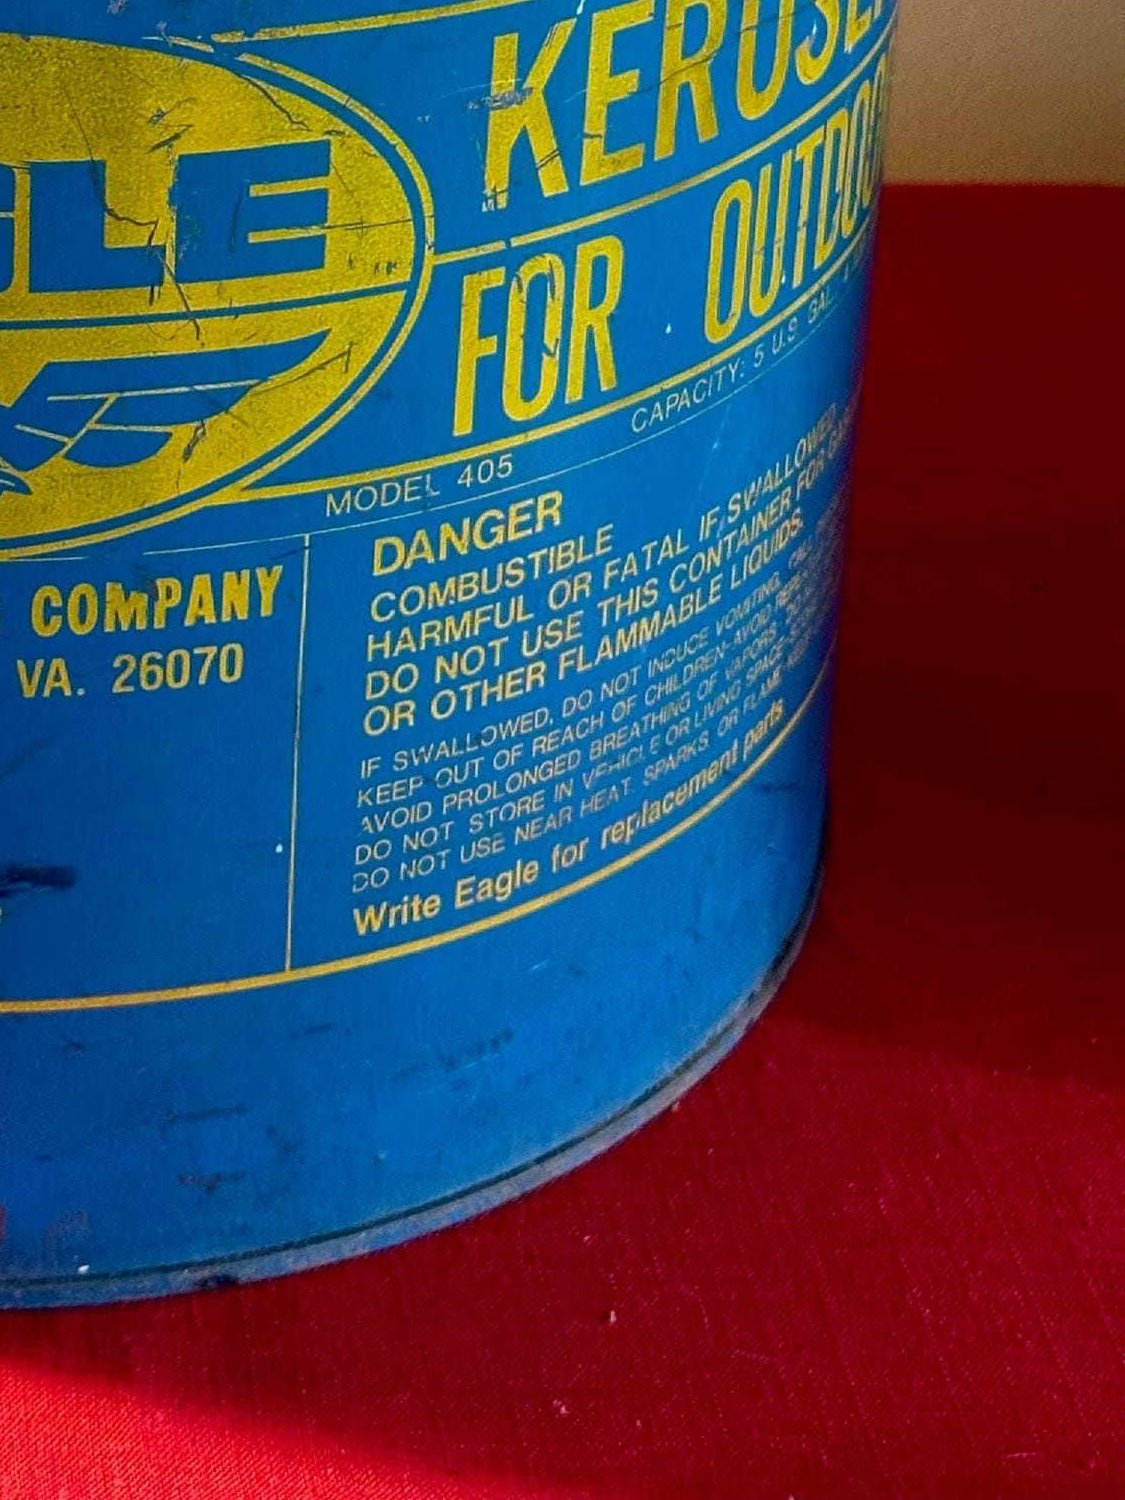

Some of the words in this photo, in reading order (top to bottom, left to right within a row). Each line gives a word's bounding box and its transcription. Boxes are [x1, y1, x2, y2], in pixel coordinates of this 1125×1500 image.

[453, 236, 624, 436] FOR
[703, 40, 891, 343] OUTDOO
[632, 357, 745, 433] CAPACITY:
[754, 344, 764, 368] 5
[326, 473, 440, 517] MODEL
[457, 453, 514, 489] 405
[372, 490, 563, 576] DANGER
[31, 565, 283, 638] COMPANY
[365, 663, 419, 701] DO
[435, 636, 509, 684] NOT
[522, 610, 584, 657] USE
[596, 577, 659, 627] THIS
[669, 485, 792, 594] CONTAINER
[367, 595, 534, 662] HARMFUL
[548, 571, 592, 611] OR
[602, 528, 689, 590] FATAL
[698, 506, 720, 543] IF
[370, 523, 614, 623] COMBUSTIBLE
[16, 657, 87, 698] VA.
[111, 642, 245, 694] 26070
[360, 756, 381, 779] IF
[562, 689, 593, 718] DO
[600, 665, 642, 702] NOT
[648, 626, 710, 679] INDUCE
[363, 699, 416, 736] OR
[430, 660, 547, 721] OTHER
[558, 572, 723, 681] FLAMMABLE
[353, 866, 390, 893] DO
[399, 849, 451, 881] NOT
[460, 832, 505, 864] USE
[514, 805, 572, 846] NEAR
[717, 706, 739, 737] OR
[353, 893, 442, 936] Write
[454, 859, 539, 910] Eagle
[551, 837, 590, 874] for
[600, 738, 740, 850] replacement
[743, 697, 784, 762] parts
[355, 839, 392, 865] DO
[403, 821, 454, 853] NOT
[469, 790, 545, 834] STORE
[554, 778, 574, 804] IN
[665, 717, 690, 747] OR
[695, 678, 741, 728] LIVING
[357, 775, 423, 808] KEEP
[434, 757, 484, 789] OUT
[493, 744, 524, 771] OF
[532, 711, 605, 757] REACH
[612, 695, 637, 723] OF
[359, 801, 432, 835] AVOID
[442, 749, 581, 815] PROLONGED
[589, 691, 691, 760] BREATHING
[697, 671, 718, 700] OF
